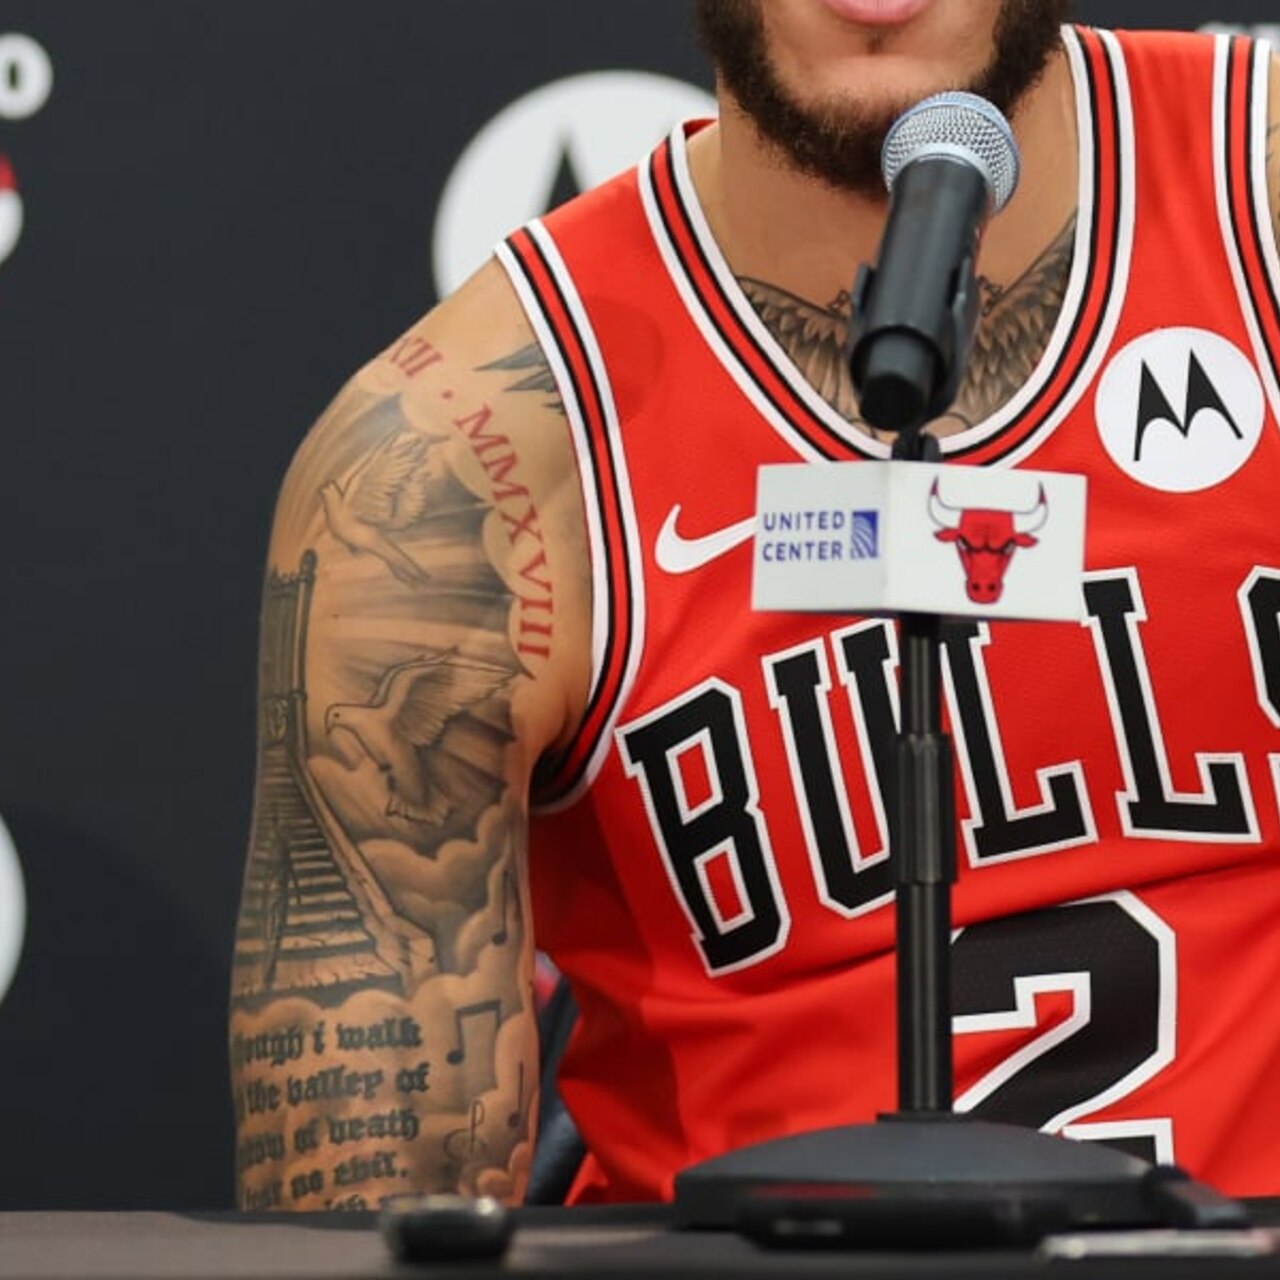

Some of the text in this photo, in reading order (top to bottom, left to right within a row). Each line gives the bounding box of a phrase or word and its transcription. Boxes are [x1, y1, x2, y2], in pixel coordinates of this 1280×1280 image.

[762, 509, 846, 532] UNITED
[762, 542, 843, 562] CENTER
[951, 888, 1177, 1167] 2
